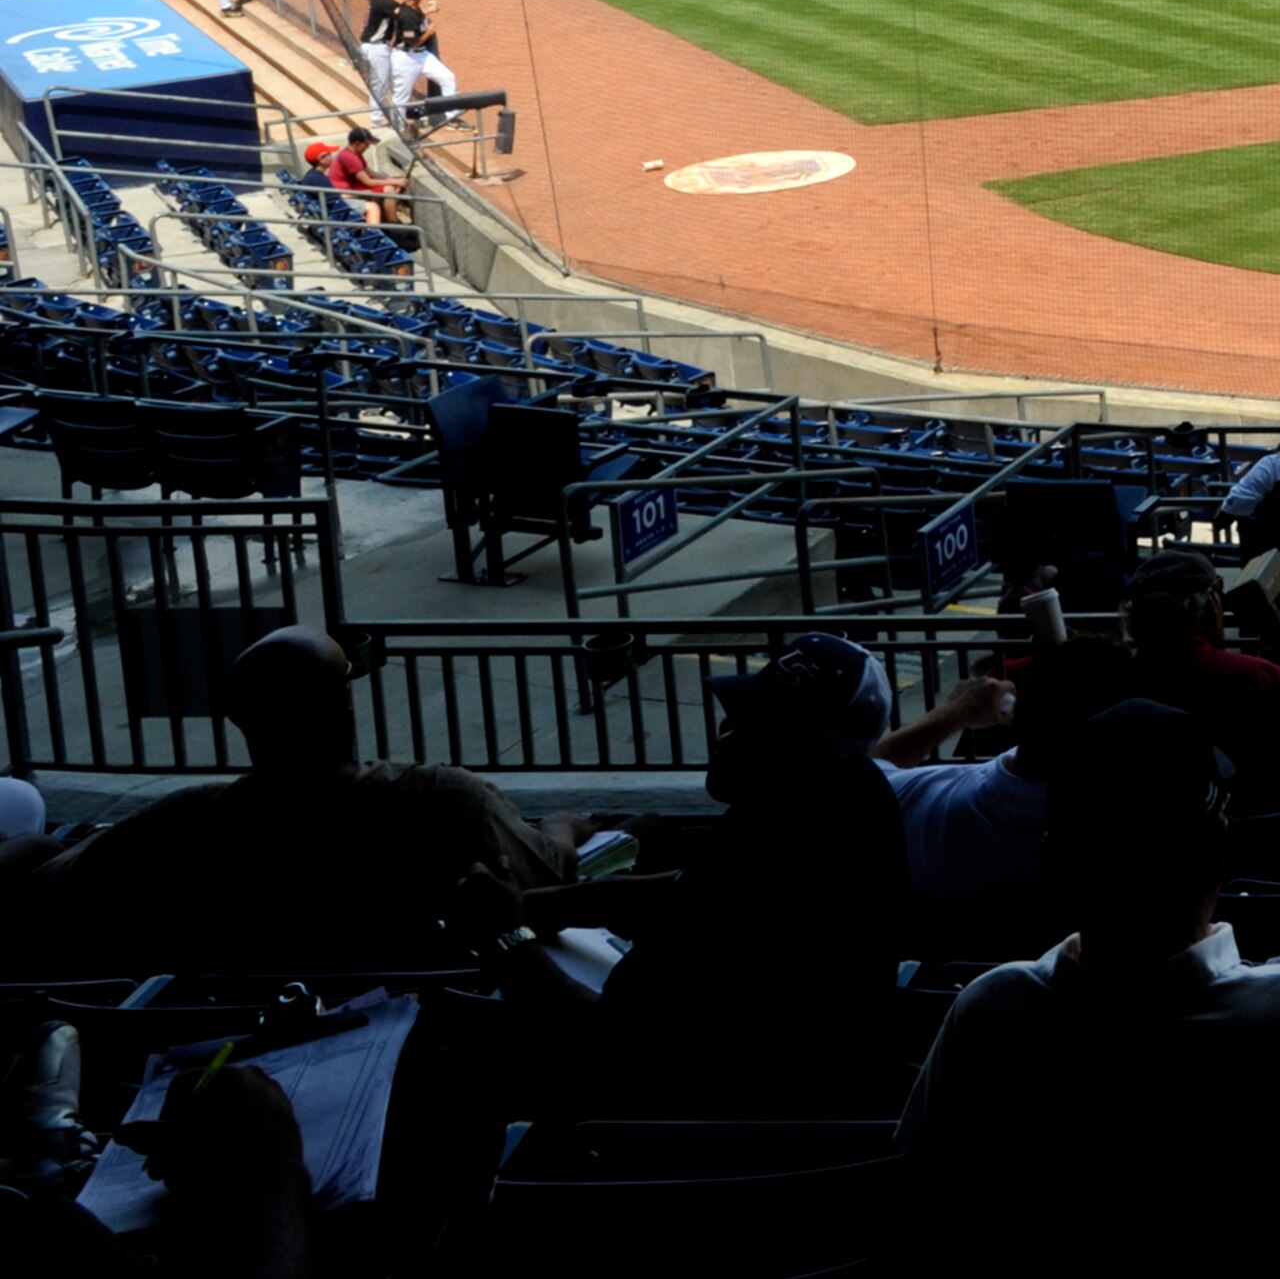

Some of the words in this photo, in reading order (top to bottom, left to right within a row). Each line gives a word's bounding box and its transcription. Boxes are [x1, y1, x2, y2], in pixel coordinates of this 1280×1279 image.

[22, 46, 83, 73] Cable
[78, 39, 138, 71] Warner
[132, 33, 182, 57] Time
[632, 494, 667, 535] 101
[934, 522, 969, 567] 100
